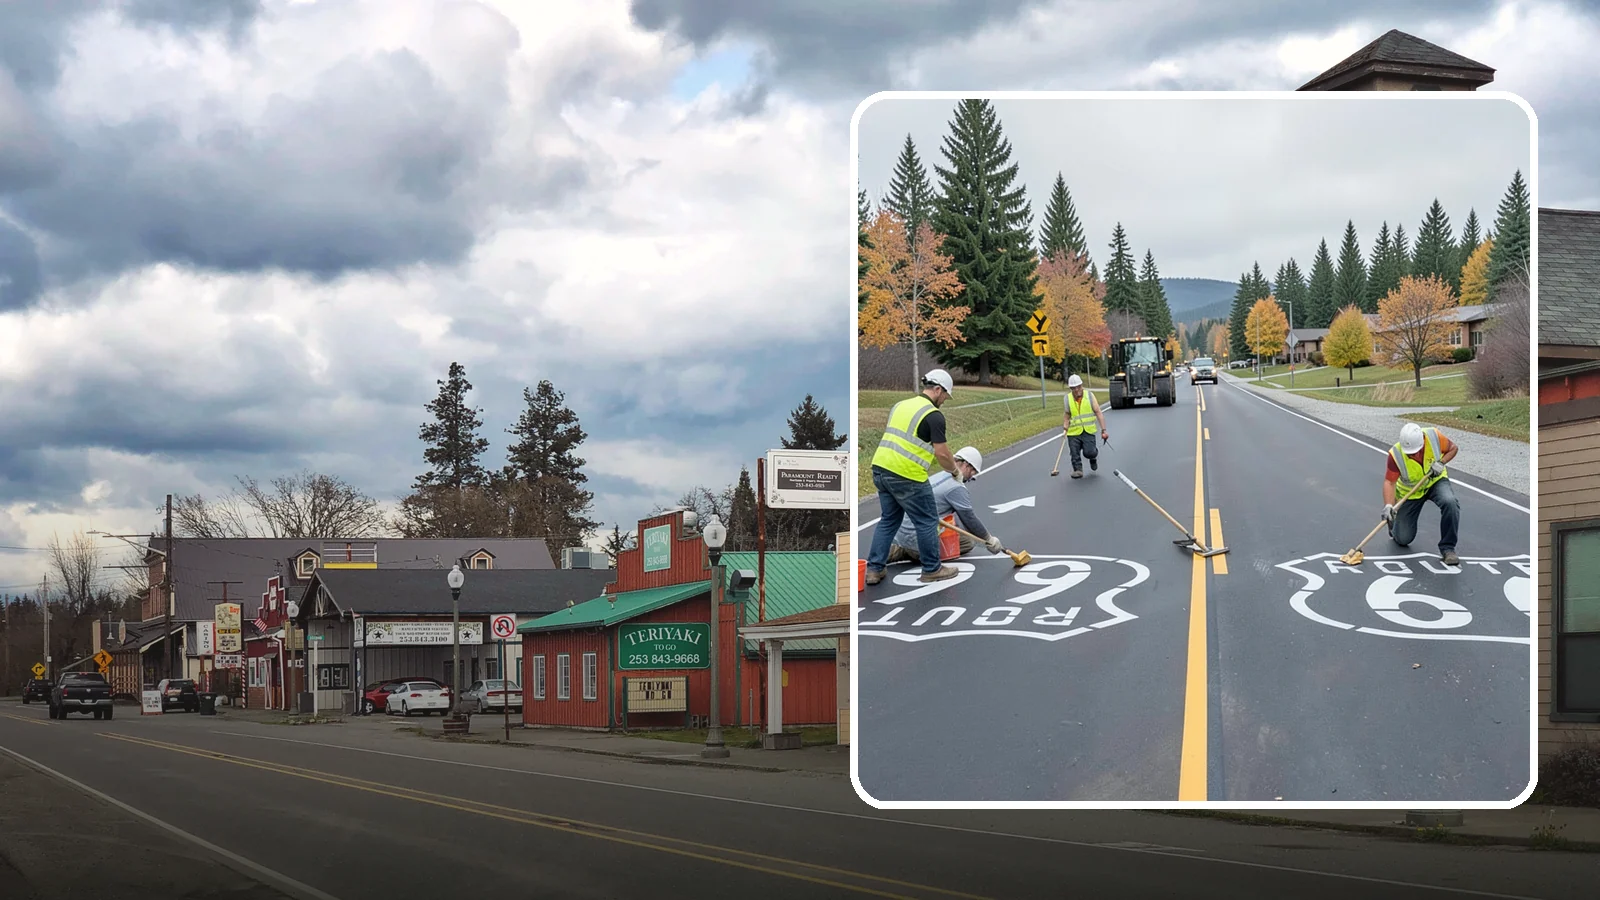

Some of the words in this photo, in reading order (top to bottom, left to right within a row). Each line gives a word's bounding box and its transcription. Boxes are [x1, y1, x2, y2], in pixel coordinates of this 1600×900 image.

[781, 471, 815, 479] PARAMOUNT
[817, 472, 839, 480] REALTY
[858, 606, 1082, 627] ROUT
[624, 627, 702, 646] TERIYAKI
[654, 643, 664, 651] TO
[665, 643, 677, 651] GO
[629, 654, 649, 665] 253
[651, 653, 700, 664] 843-9668
